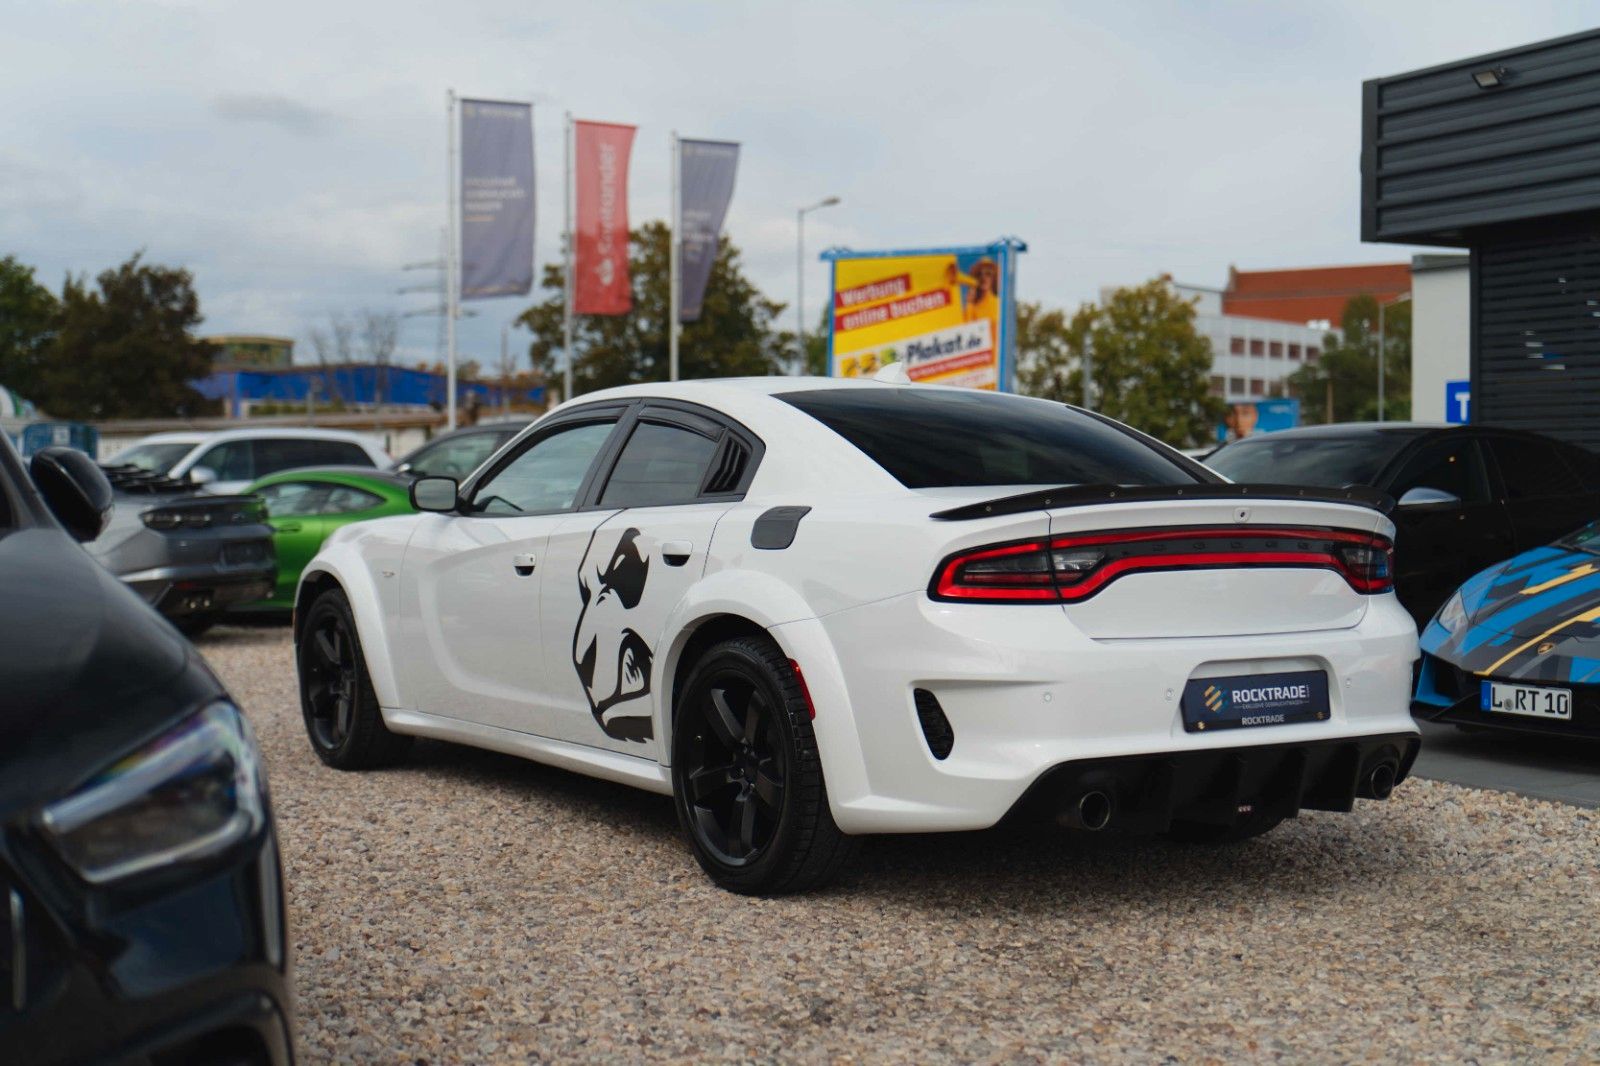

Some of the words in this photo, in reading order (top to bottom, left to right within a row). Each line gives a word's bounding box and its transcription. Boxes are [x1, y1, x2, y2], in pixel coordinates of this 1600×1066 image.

[840, 279, 905, 305] Werbung
[842, 306, 888, 330] online
[891, 291, 946, 317] buchen
[1232, 685, 1306, 703] ROCKTRADE
[1492, 687, 1503, 708] L
[1515, 689, 1540, 712] RT
[1544, 693, 1568, 715] 10
[1242, 715, 1284, 725] ROCKTRADE
